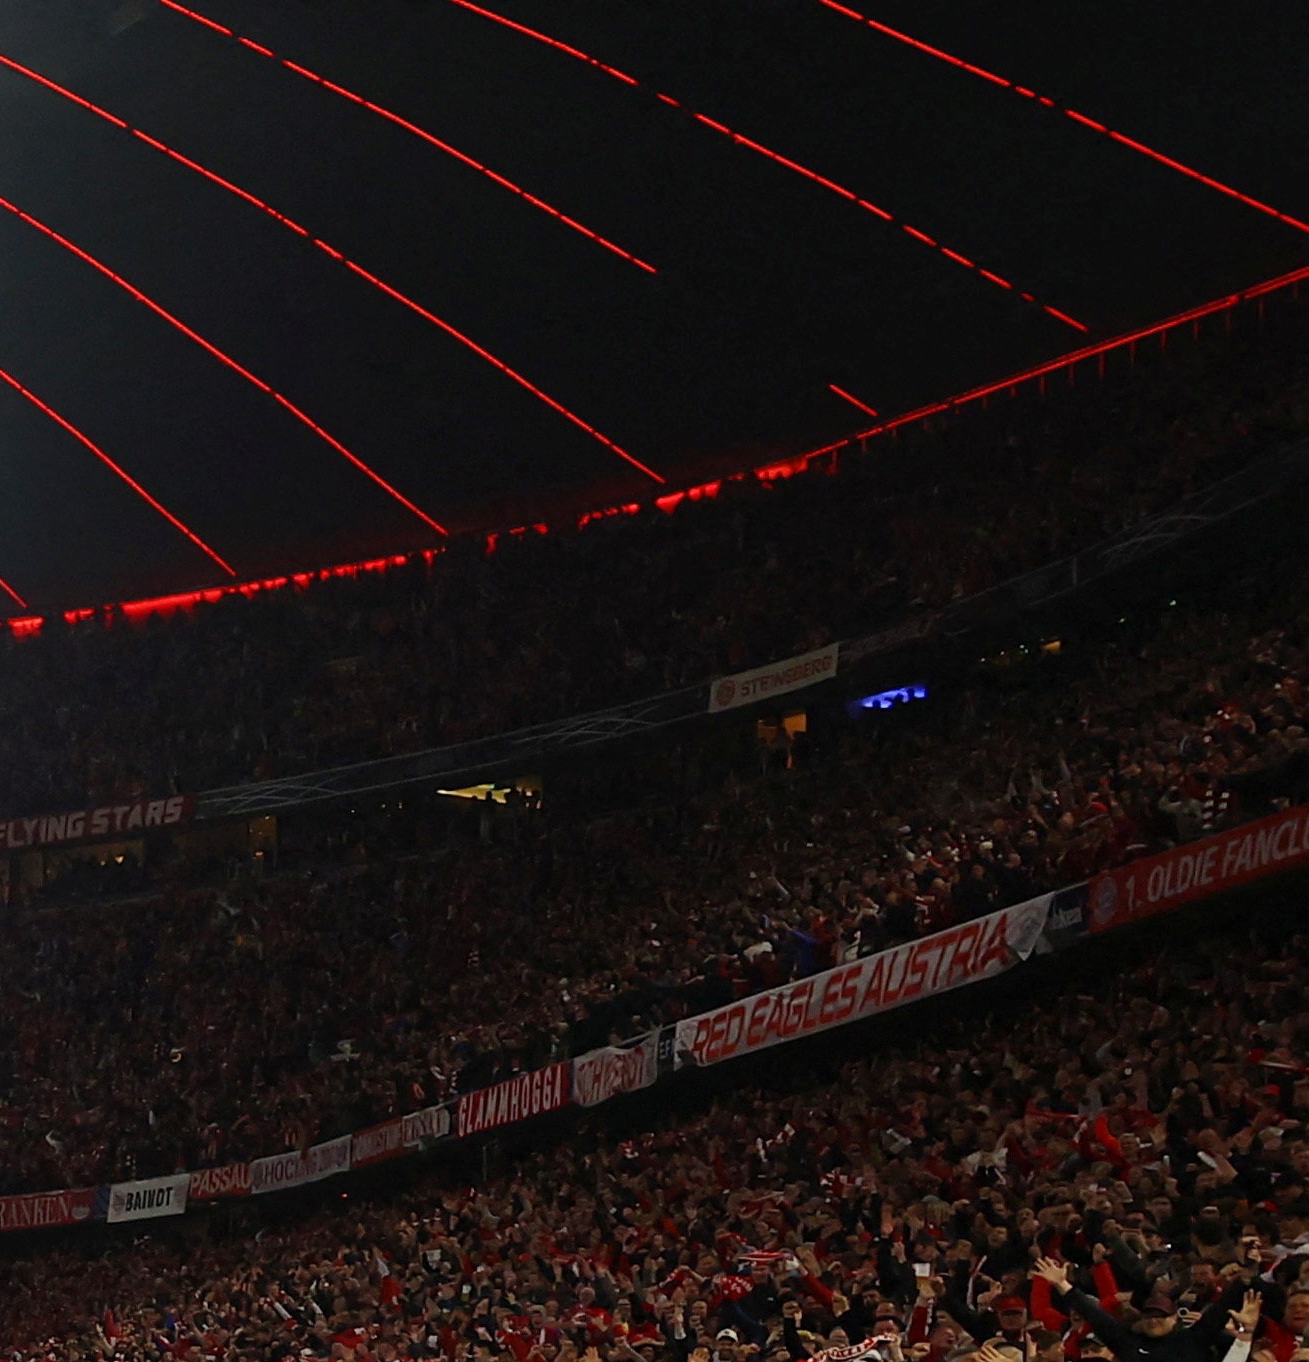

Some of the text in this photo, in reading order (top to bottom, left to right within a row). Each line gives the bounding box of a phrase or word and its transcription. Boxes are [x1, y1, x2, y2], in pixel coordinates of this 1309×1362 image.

[741, 656, 834, 698] STEINSBERG
[90, 797, 184, 835] STARS
[1146, 850, 1217, 903] OLDIE
[692, 912, 1011, 1062] RED EAGLES AUSTRIA
[188, 1162, 251, 1195] PASSAU
